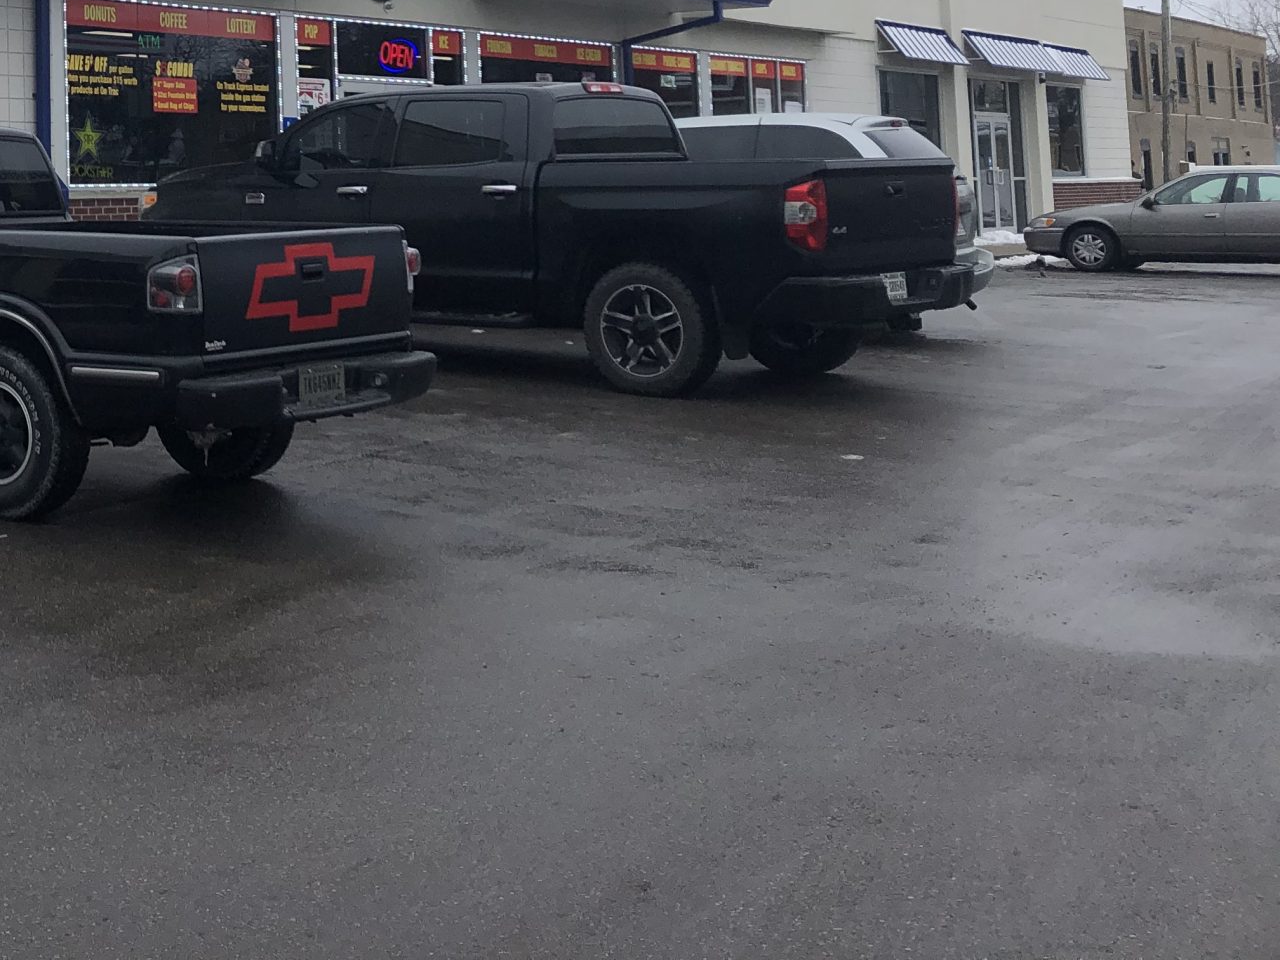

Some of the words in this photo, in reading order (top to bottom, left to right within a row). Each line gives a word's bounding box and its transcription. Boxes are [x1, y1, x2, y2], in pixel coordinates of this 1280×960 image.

[84, 4, 117, 23] DONUTS
[159, 11, 188, 29] COFFEE
[226, 17, 257, 35] LOTTERY
[304, 23, 319, 39] POP
[137, 34, 161, 49] ATM
[439, 36, 449, 50] ICE
[66, 54, 84, 71] SAVE
[94, 56, 108, 72] OFF
[380, 41, 414, 69] OPEN
[167, 61, 194, 78] COMBO
